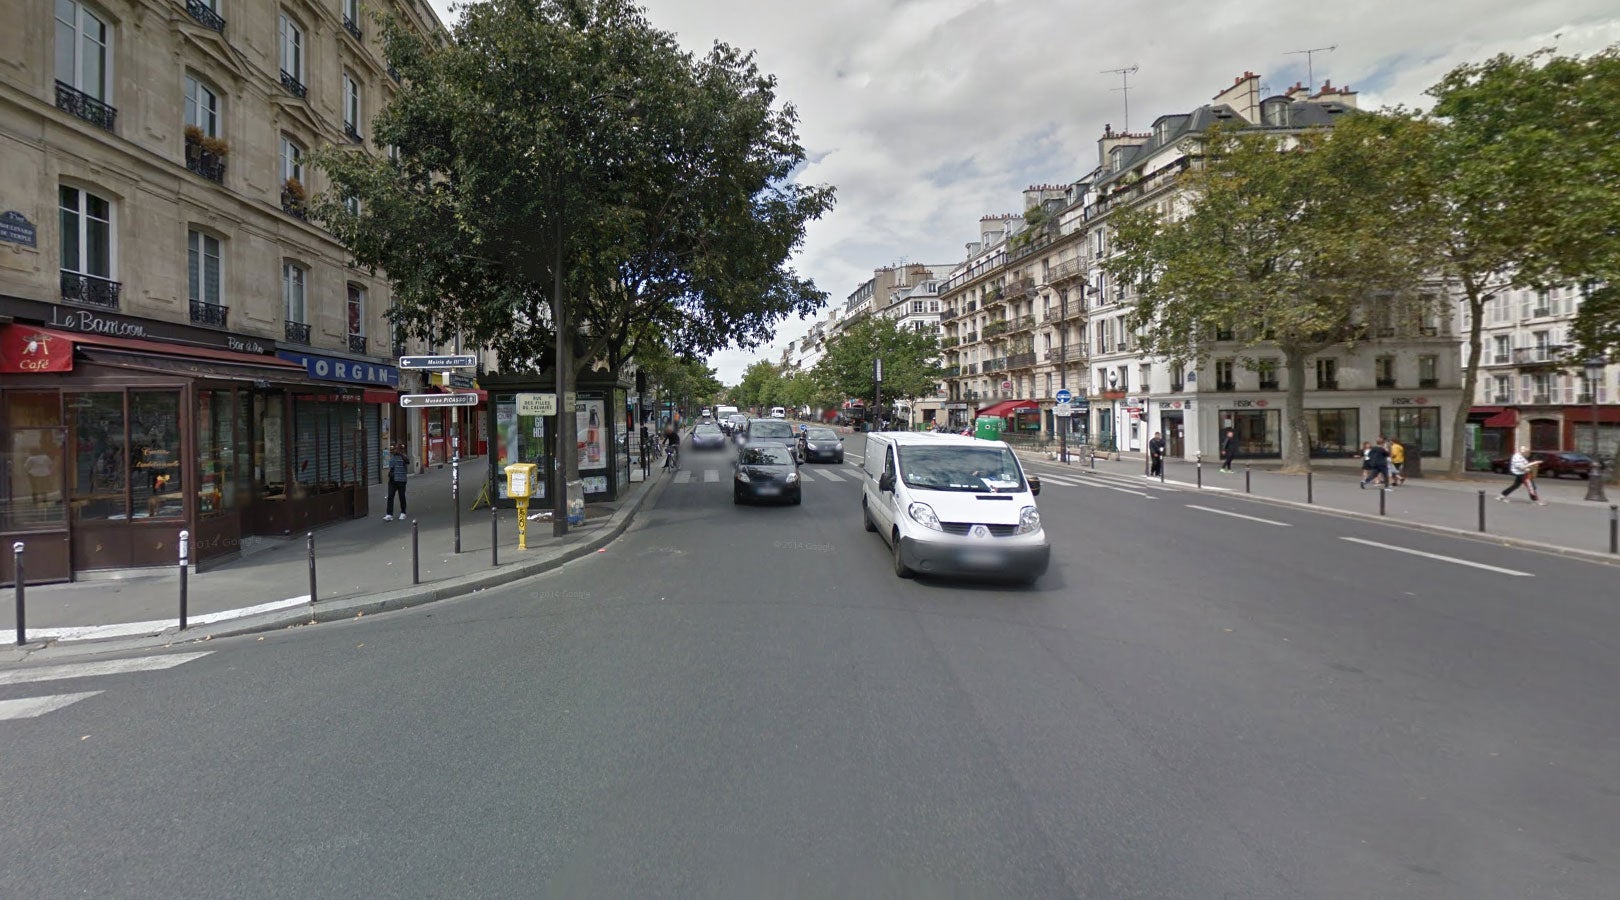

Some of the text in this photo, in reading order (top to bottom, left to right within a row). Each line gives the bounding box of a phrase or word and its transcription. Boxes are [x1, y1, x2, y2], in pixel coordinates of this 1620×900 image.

[48, 306, 75, 328] Le
[227, 336, 244, 350] Bar
[19, 359, 49, 372] Café
[1233, 400, 1256, 408] HSBC
